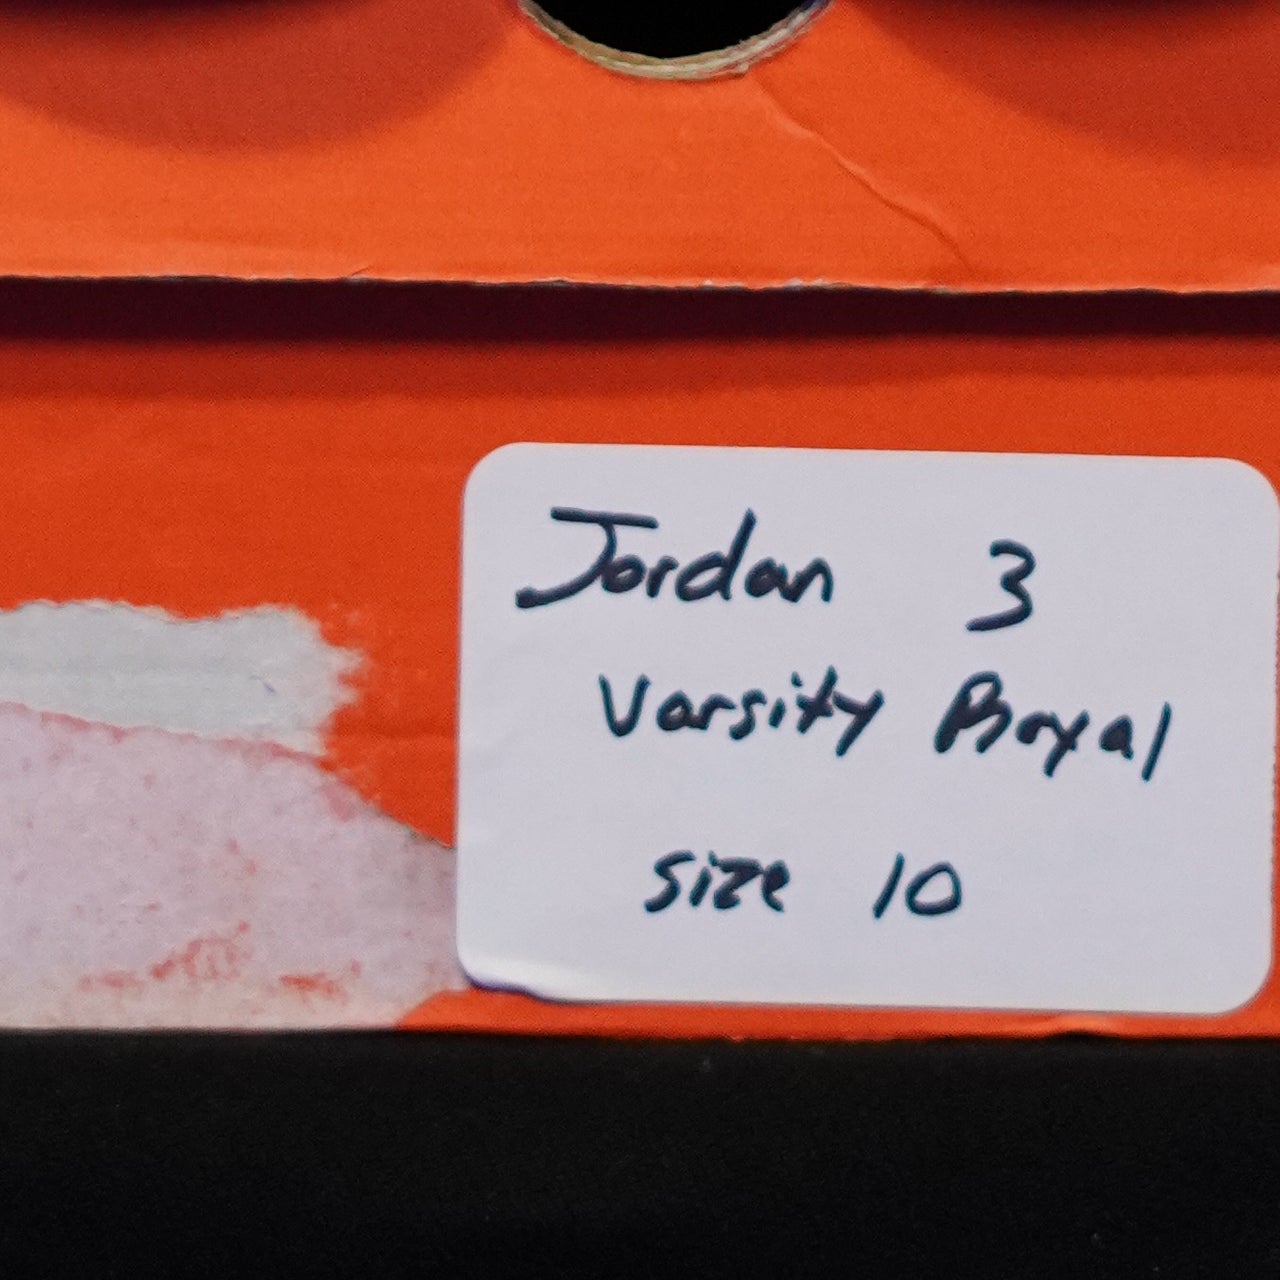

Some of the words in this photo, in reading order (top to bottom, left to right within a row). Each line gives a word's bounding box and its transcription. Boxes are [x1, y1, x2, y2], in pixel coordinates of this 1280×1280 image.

[515, 507, 834, 610] Jordan
[966, 540, 1036, 633] 3
[598, 666, 885, 757] Varsity
[933, 671, 1172, 782] Royal
[644, 851, 790, 914] size
[872, 854, 963, 920] 10
